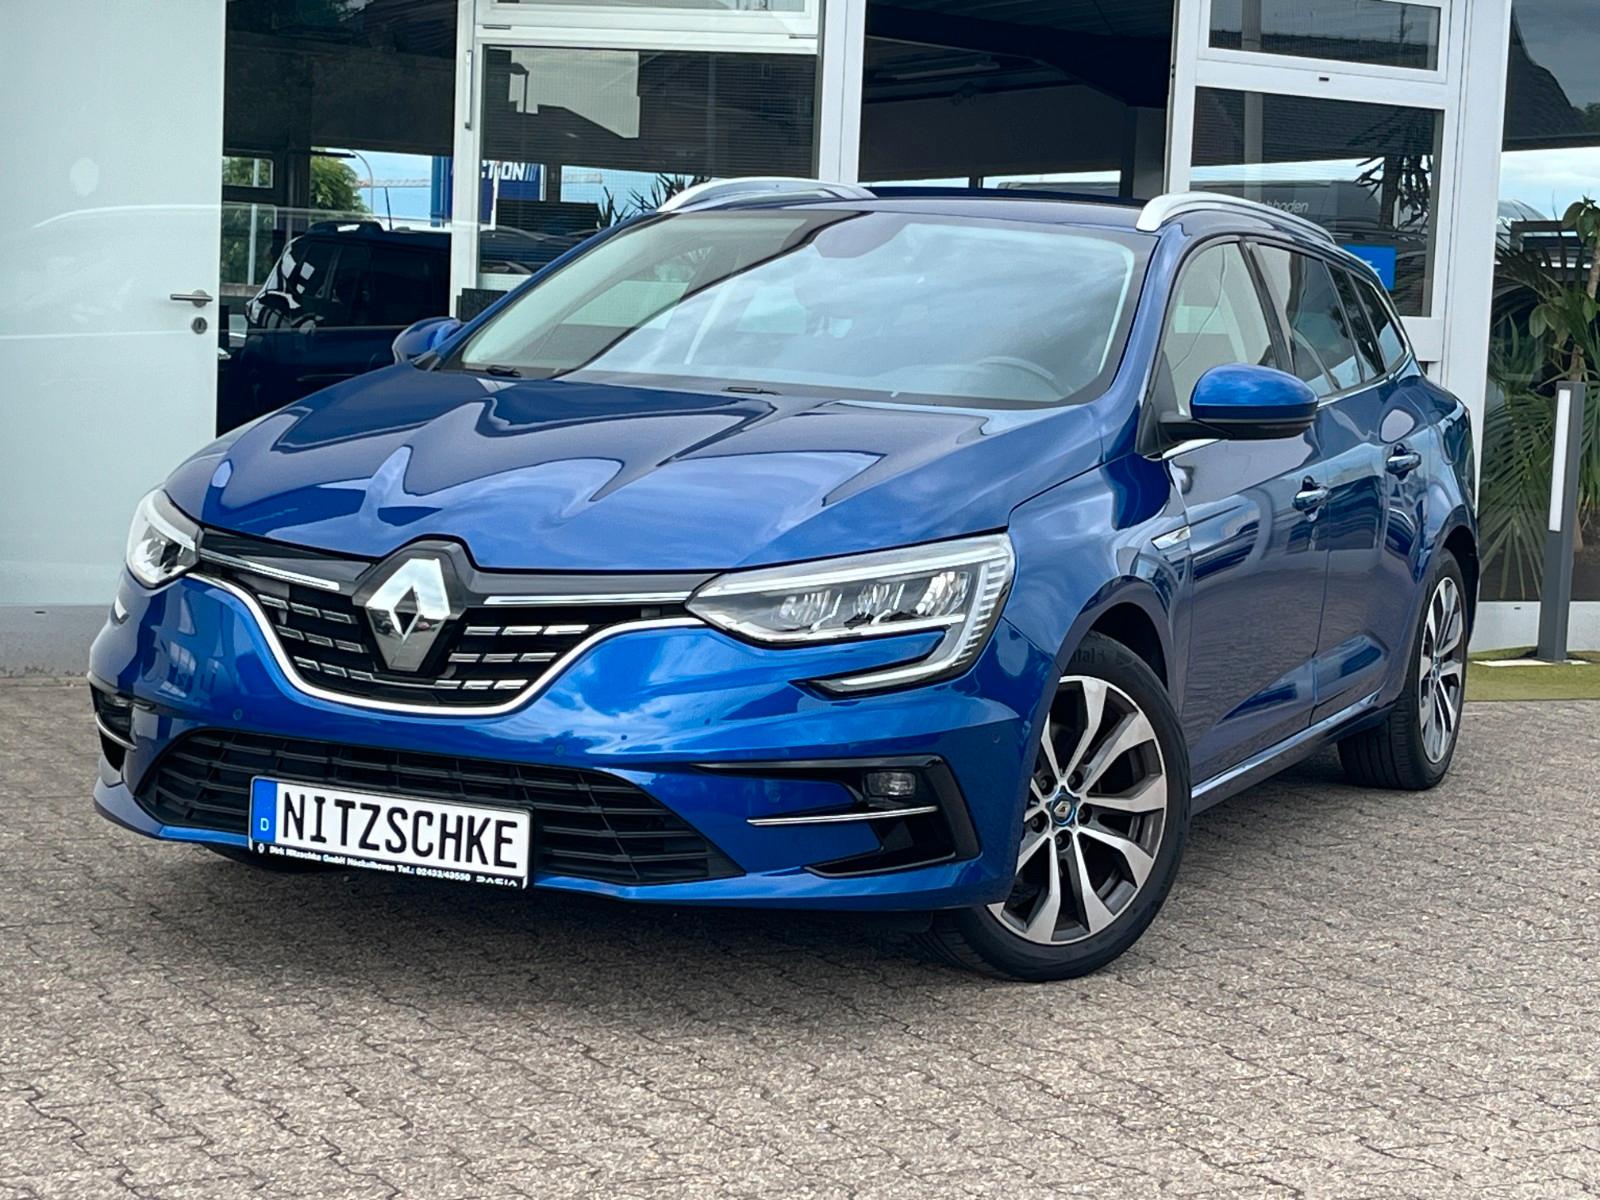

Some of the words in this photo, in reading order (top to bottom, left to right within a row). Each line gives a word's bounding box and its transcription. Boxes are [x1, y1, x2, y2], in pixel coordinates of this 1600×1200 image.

[260, 817, 270, 832] D
[283, 791, 519, 869] NITZSCHKE
[322, 854, 346, 865] GmbH
[475, 875, 518, 888] DACIA
